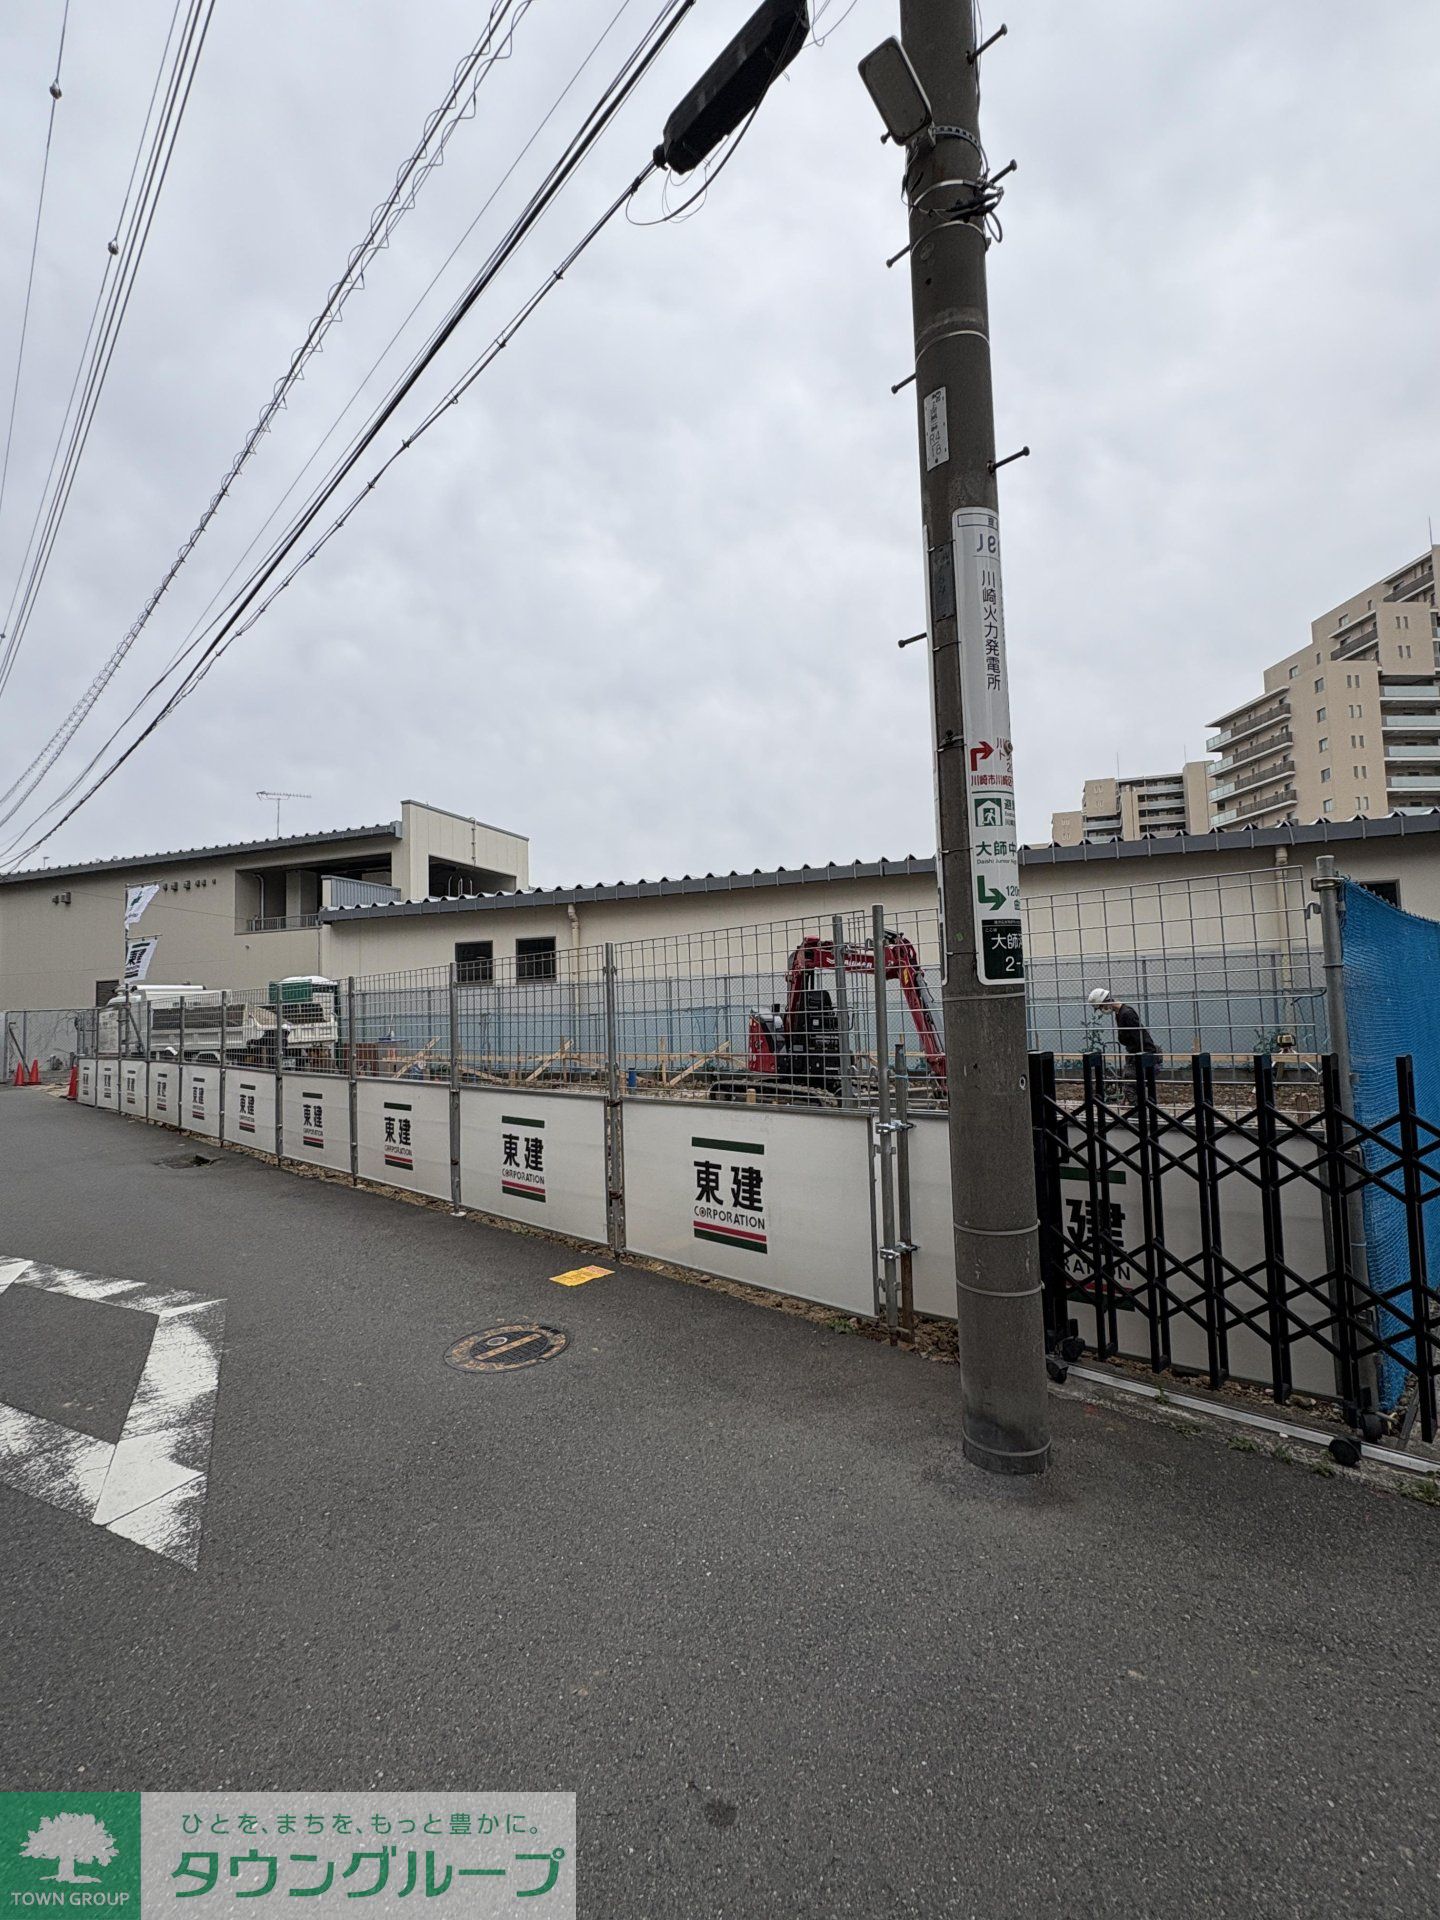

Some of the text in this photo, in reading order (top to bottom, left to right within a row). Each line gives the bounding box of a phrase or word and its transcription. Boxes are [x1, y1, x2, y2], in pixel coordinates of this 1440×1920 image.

[980, 569, 1001, 692] 川崎火力発電所
[239, 1093, 255, 1116] 東建
[302, 1104, 323, 1129] 東建
[383, 1115, 412, 1146] 東建
[502, 1132, 544, 1172] 東建
[501, 1167, 545, 1185] CORPORATION
[693, 1160, 764, 1213] 東建
[693, 1205, 766, 1231] CORPORATION
